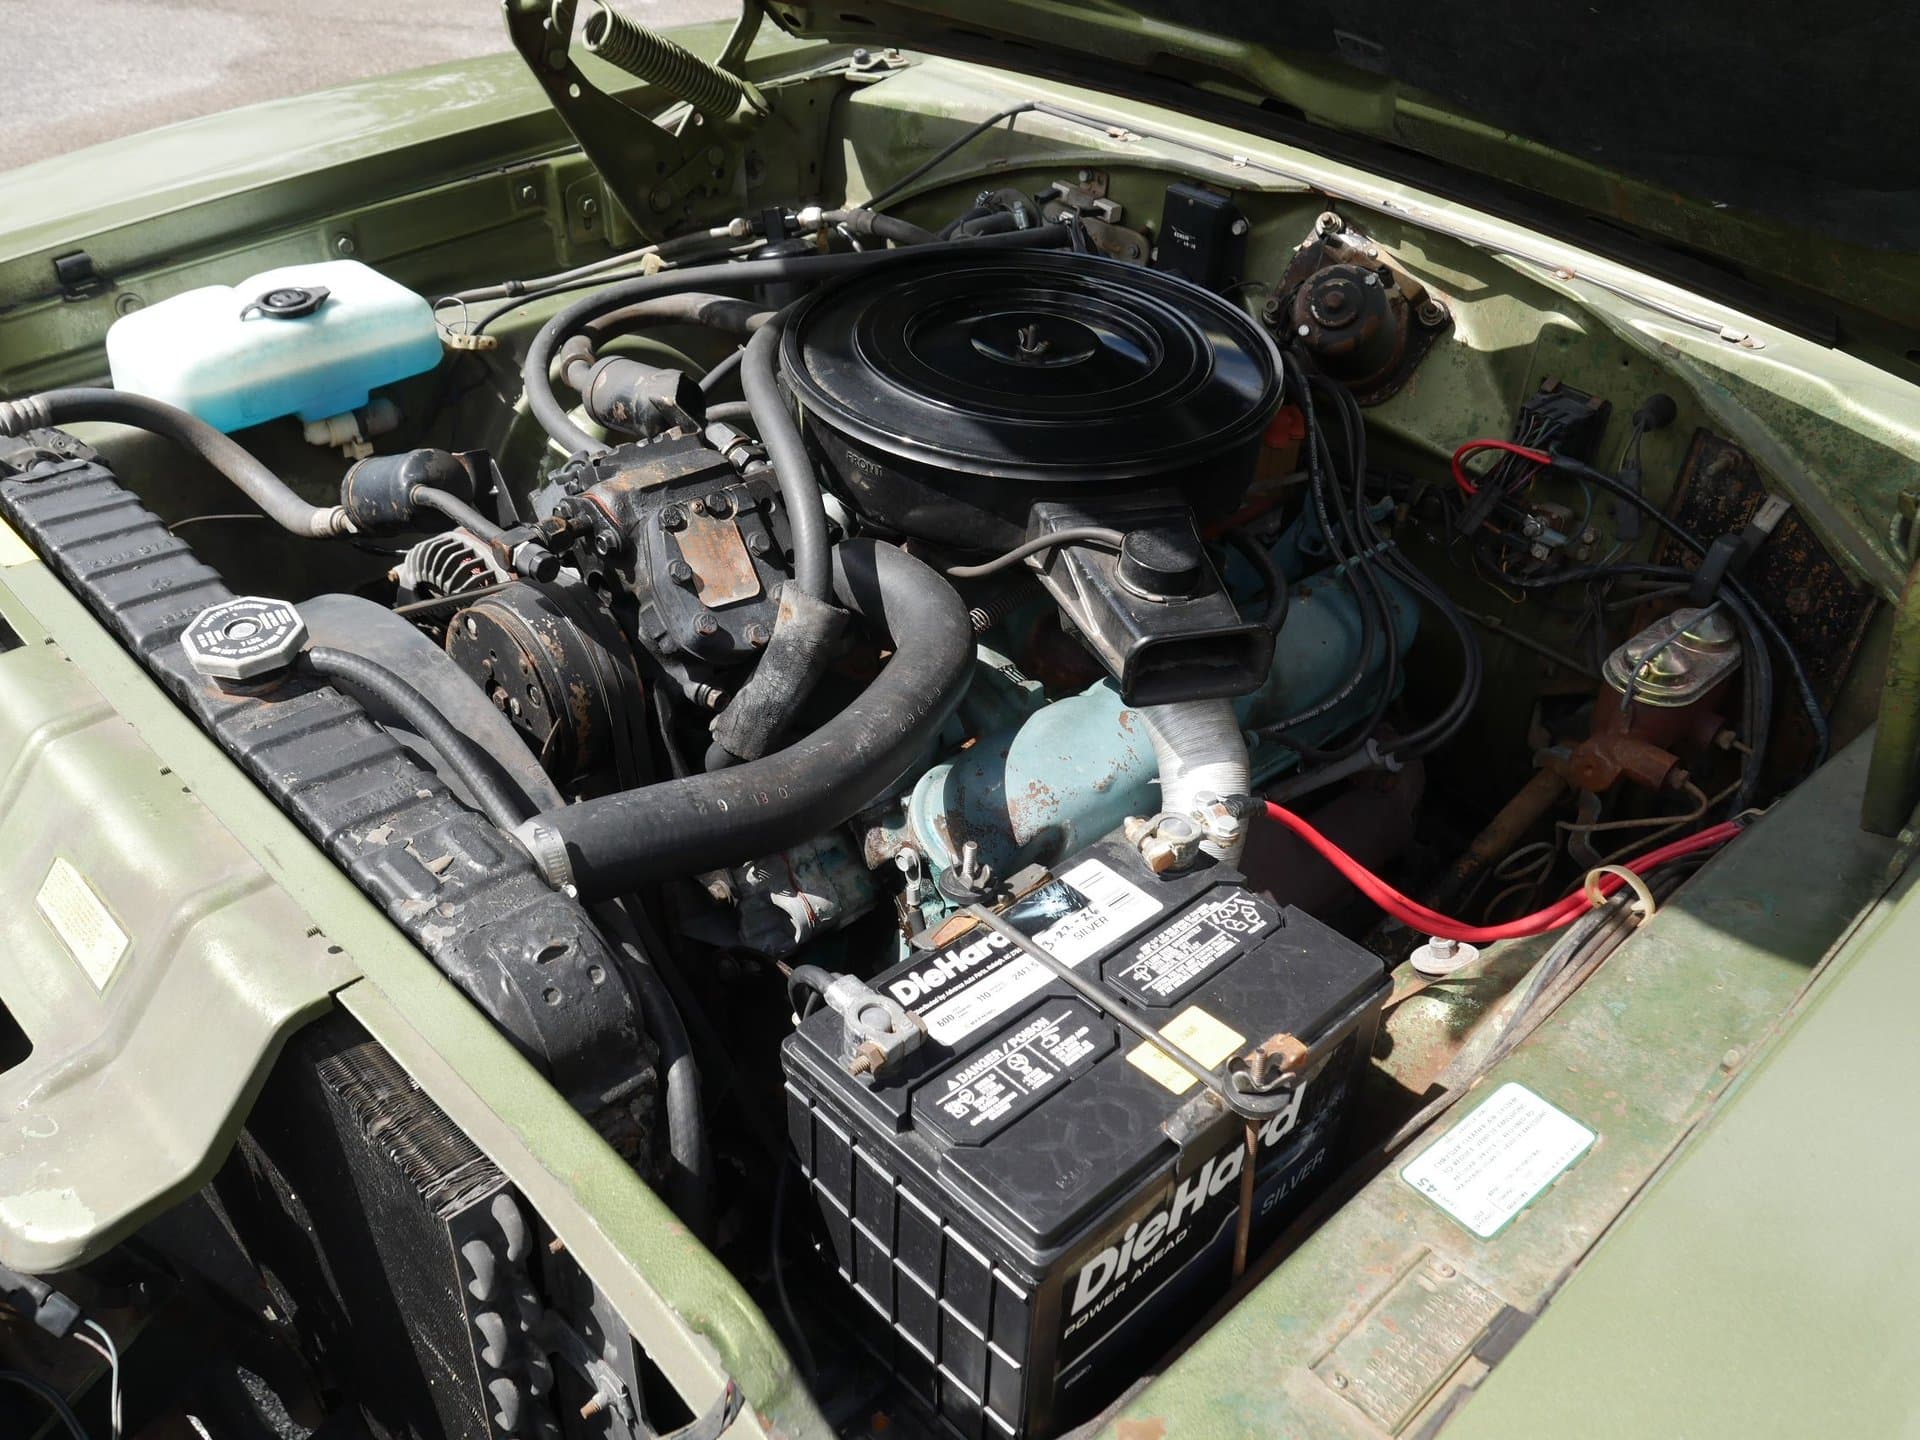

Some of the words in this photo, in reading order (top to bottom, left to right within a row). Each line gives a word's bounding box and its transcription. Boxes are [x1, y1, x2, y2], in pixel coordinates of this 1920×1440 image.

[1073, 916, 1109, 941] SILVER
[955, 1049, 1004, 1084] DANGER
[1008, 1016, 1051, 1048] POISON
[1261, 1148, 1326, 1216] SILVER
[1063, 1281, 1127, 1339] POWER
[1131, 1229, 1188, 1284] AHEAD
